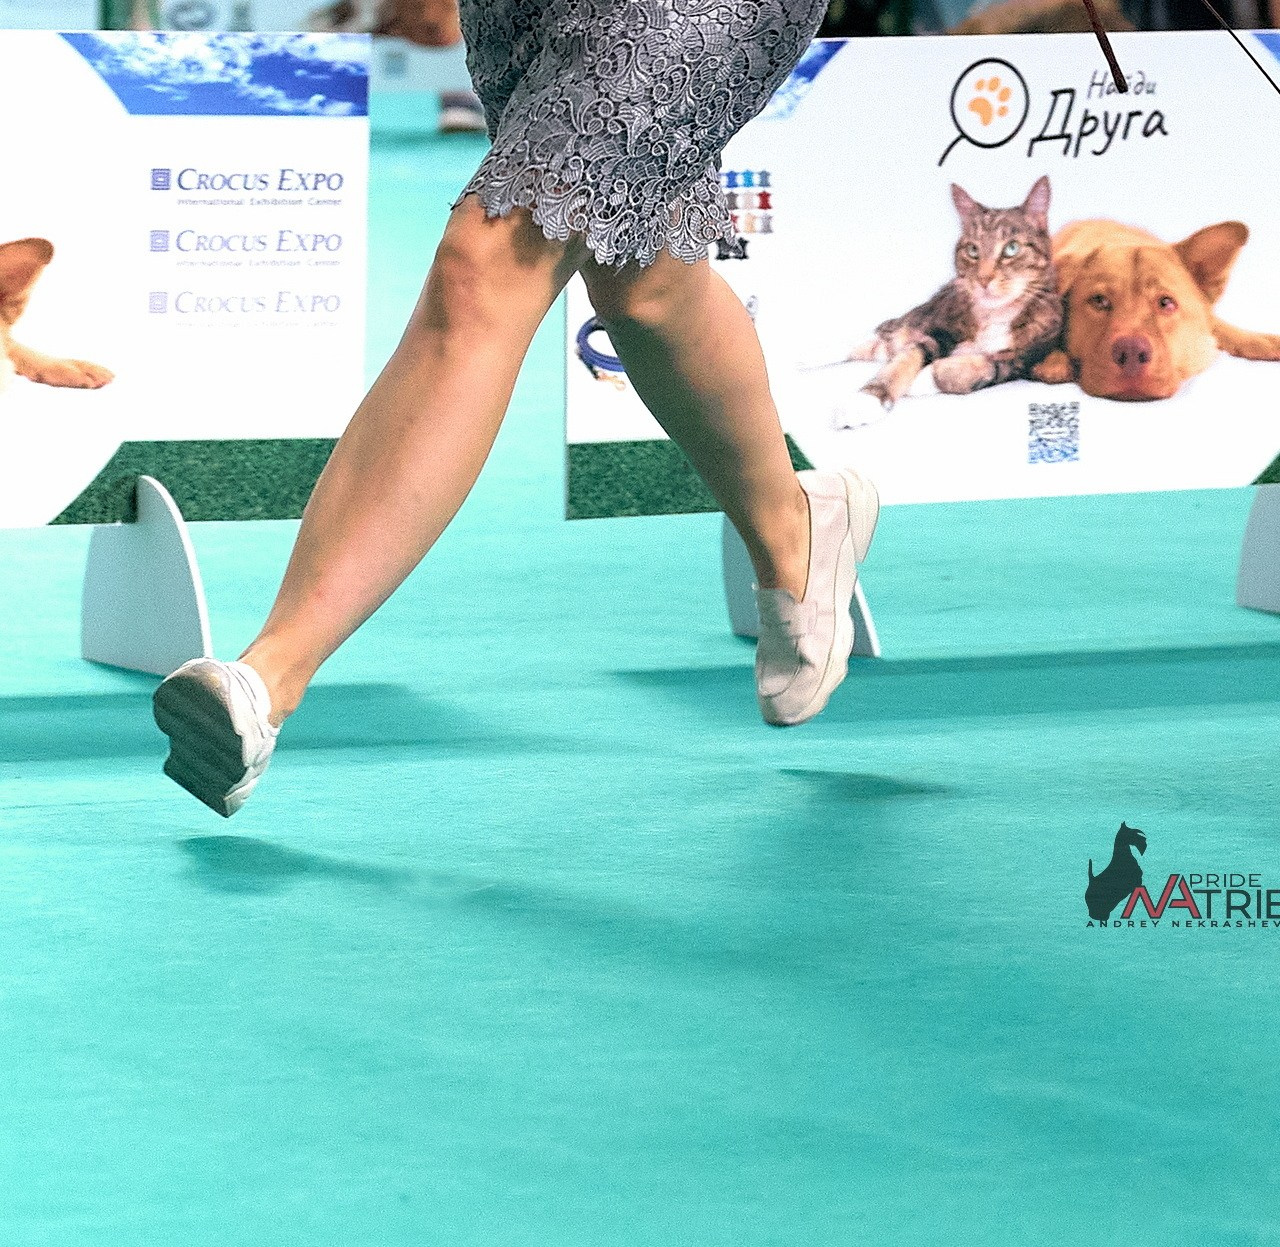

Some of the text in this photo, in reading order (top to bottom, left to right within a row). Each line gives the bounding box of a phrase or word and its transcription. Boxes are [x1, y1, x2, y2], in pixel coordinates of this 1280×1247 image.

[1087, 69, 1156, 99] Нади
[1028, 88, 1168, 158] Друга
[177, 168, 344, 190] CROCUS EXPO
[176, 230, 342, 252] CROCUS EXPO
[276, 291, 340, 313] EXPO
